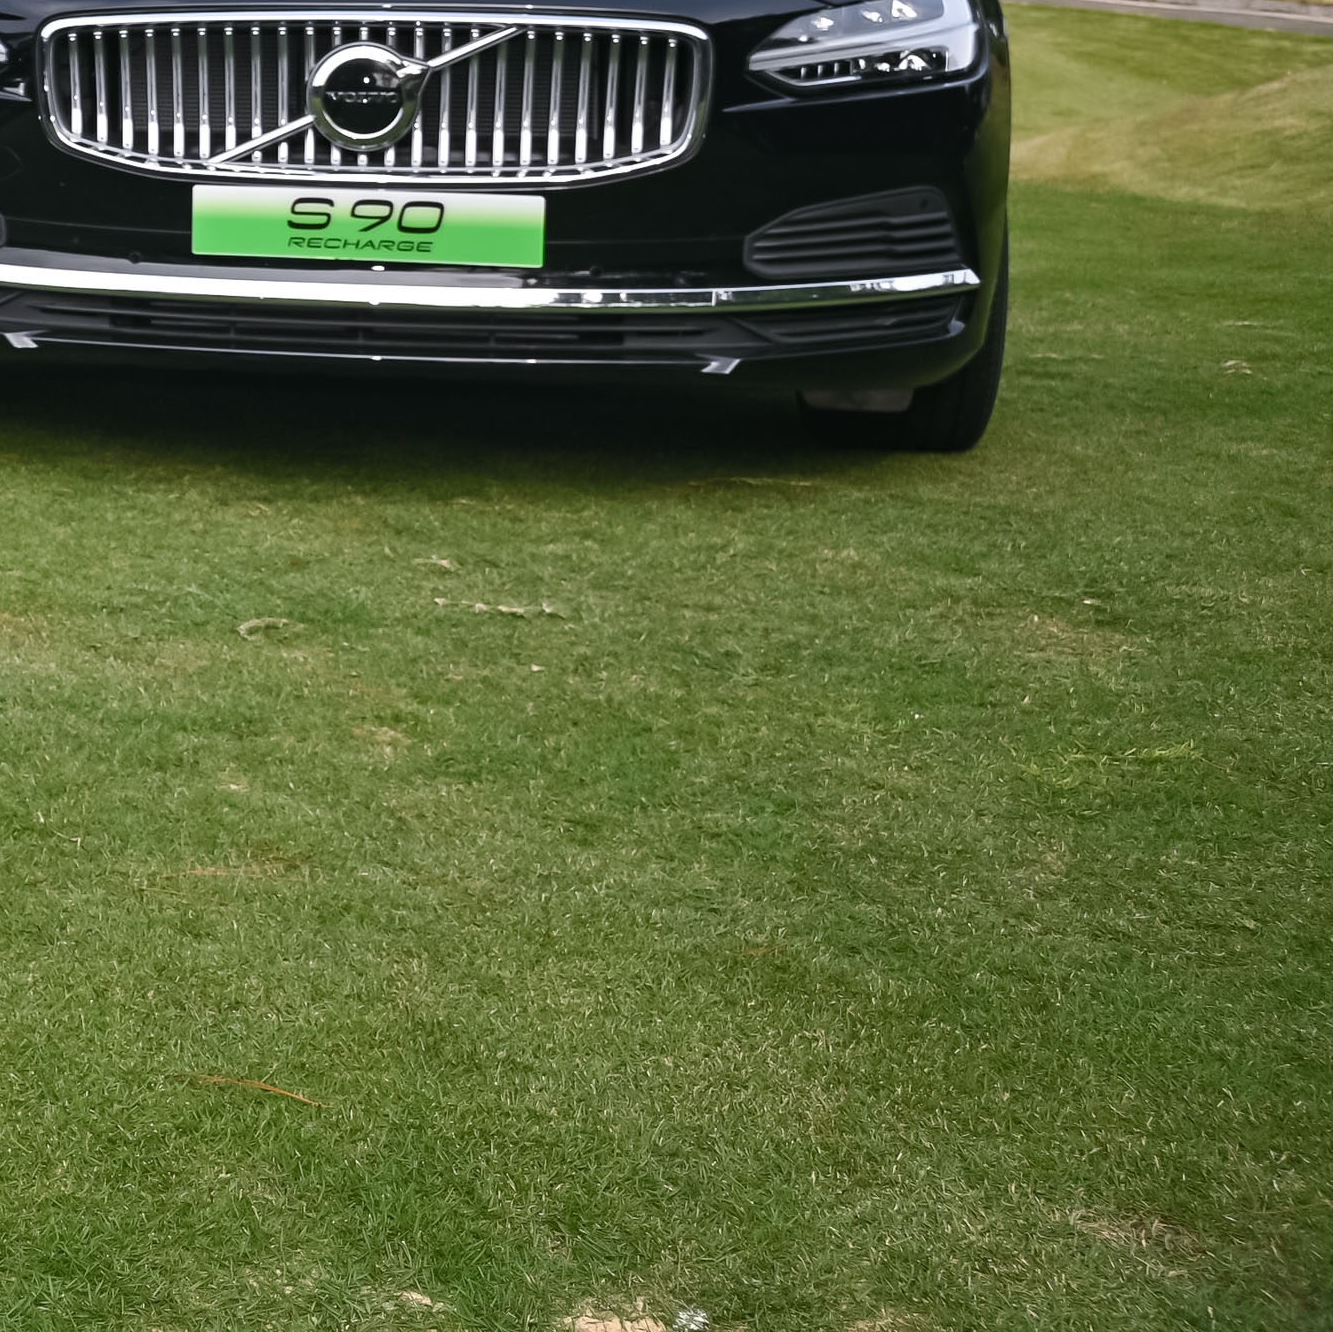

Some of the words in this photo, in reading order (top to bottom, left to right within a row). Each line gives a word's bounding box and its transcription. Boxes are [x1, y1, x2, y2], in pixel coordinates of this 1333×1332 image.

[286, 196, 335, 231] S
[350, 199, 445, 234] 90
[286, 236, 434, 253] RECHARGE
